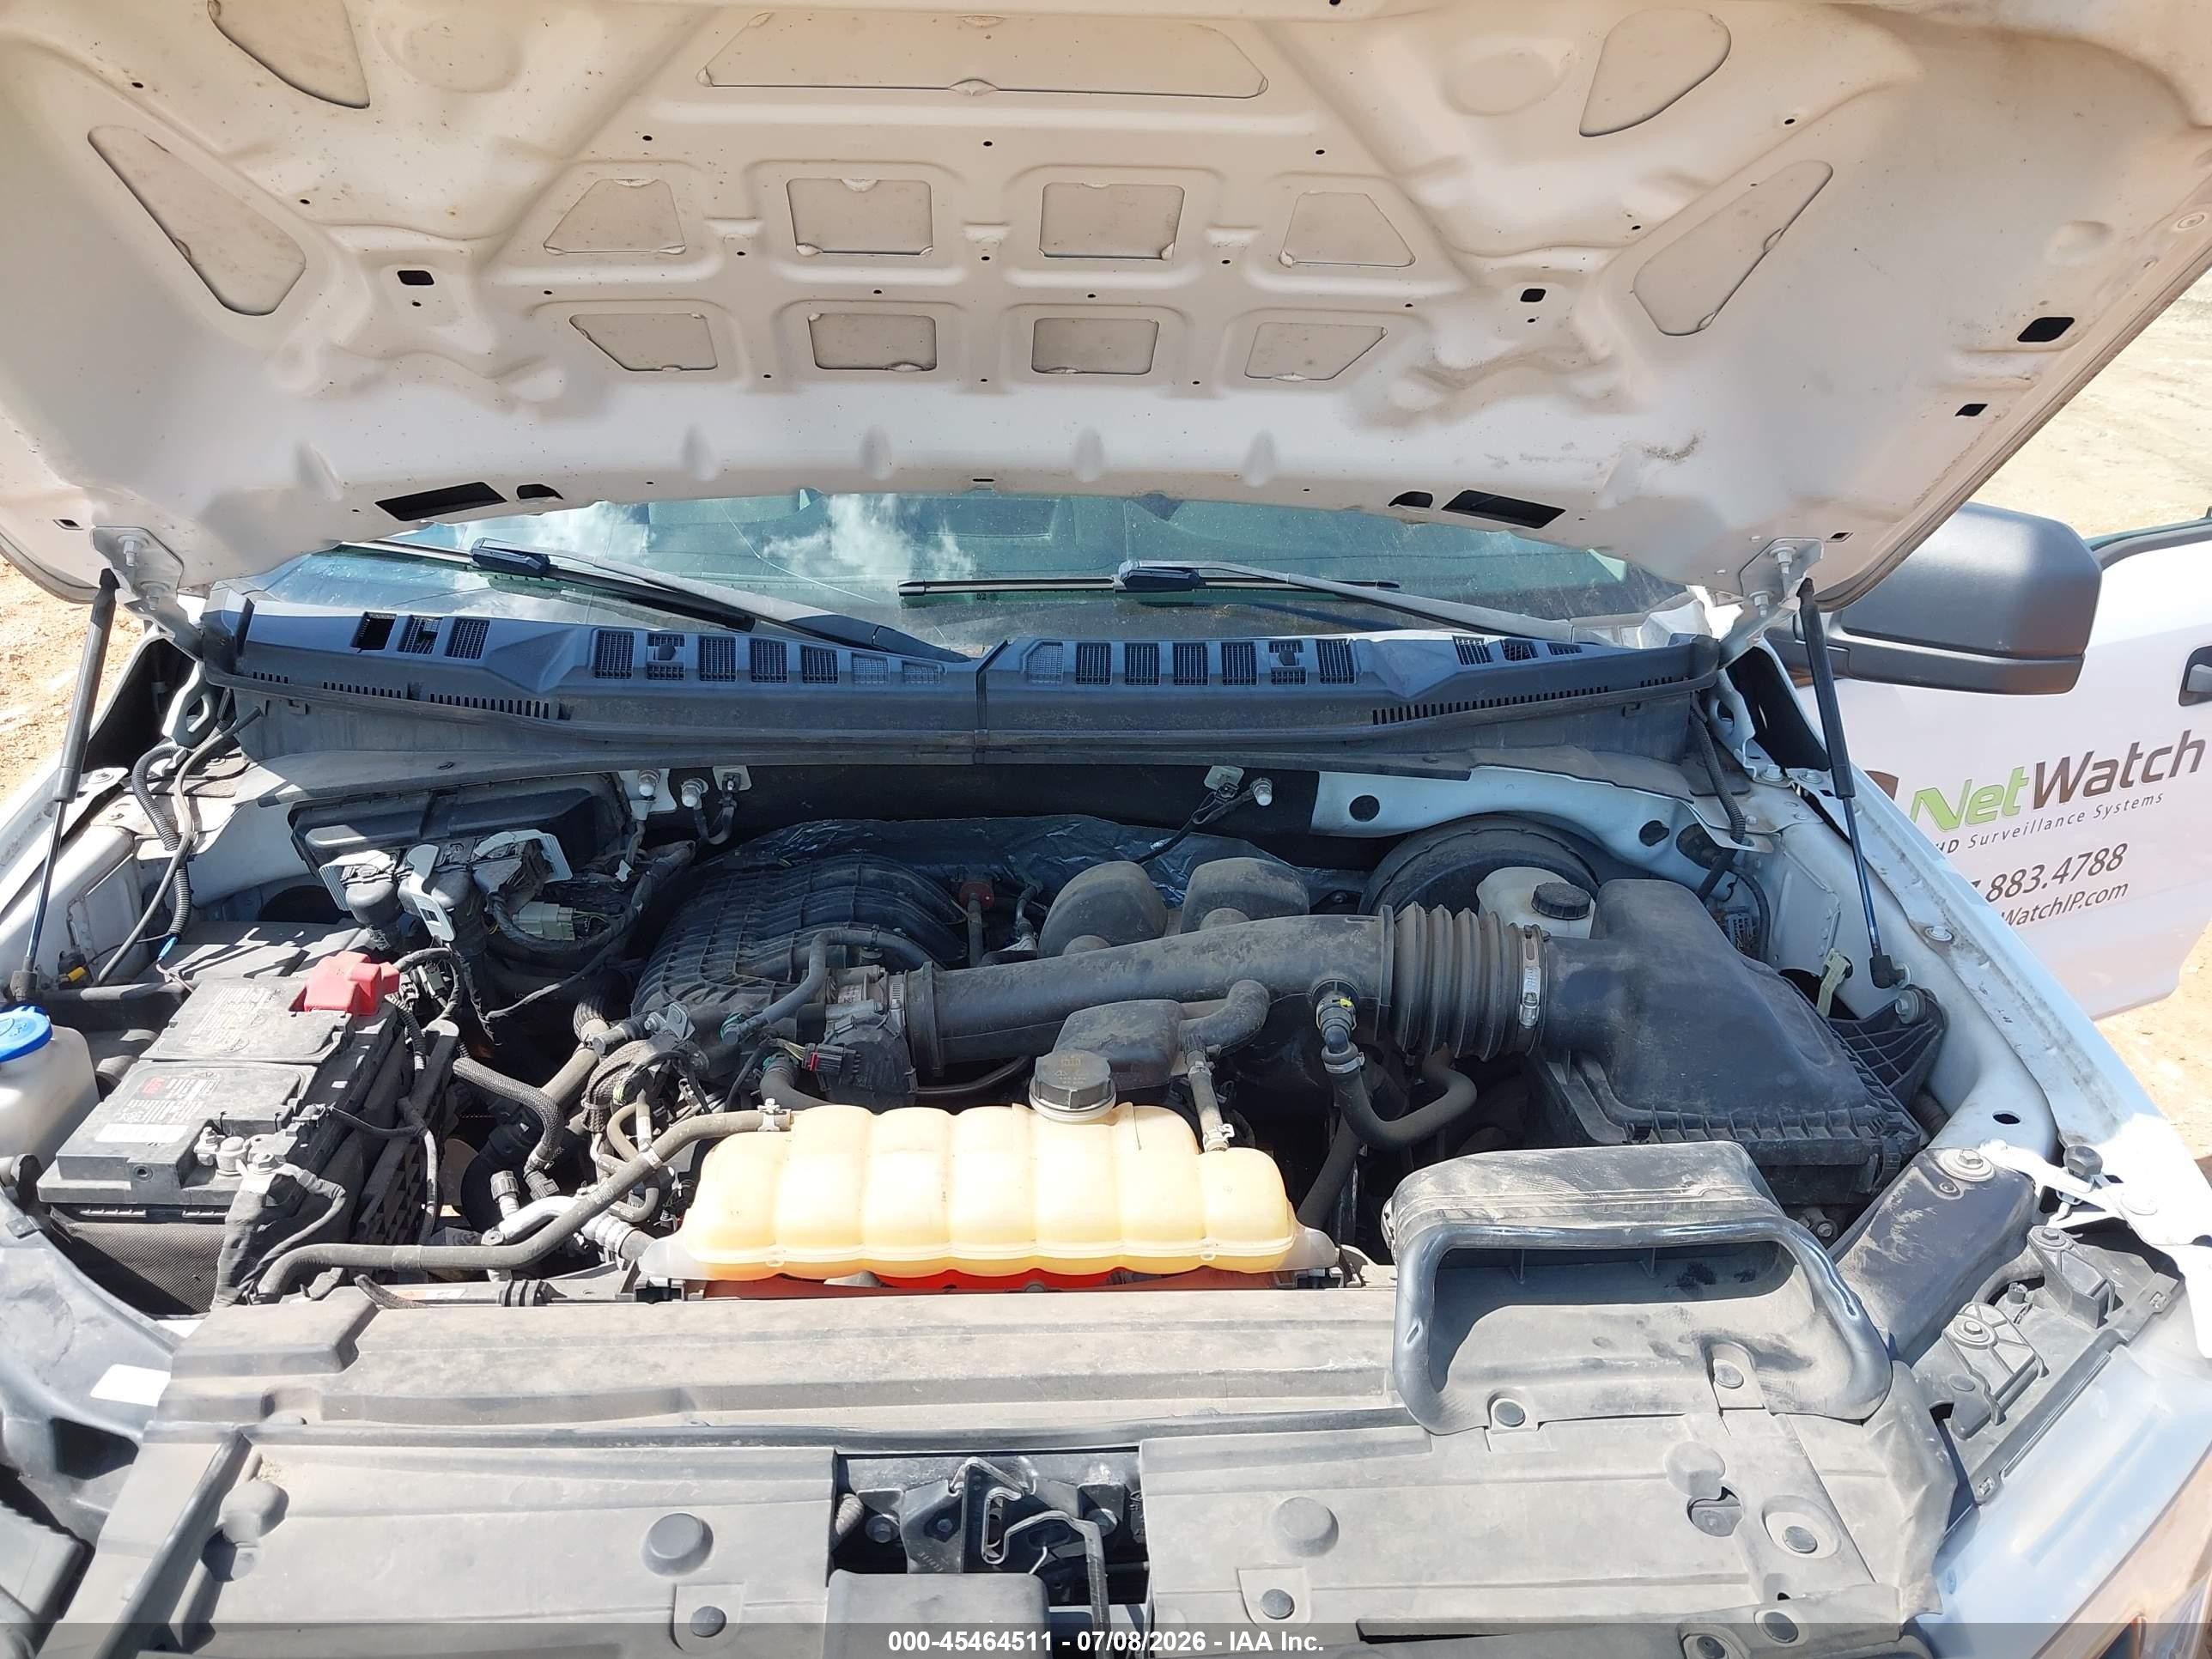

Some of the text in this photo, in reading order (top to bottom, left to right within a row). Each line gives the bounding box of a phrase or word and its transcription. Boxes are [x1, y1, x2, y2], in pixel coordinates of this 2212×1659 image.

[1909, 729, 2206, 831] NetWatch
[1967, 811, 2086, 849] Surveillance
[2093, 793, 2164, 821] Systems
[1971, 842, 2128, 902] 883.4788
[2001, 883, 2129, 927] WatchIP.com
